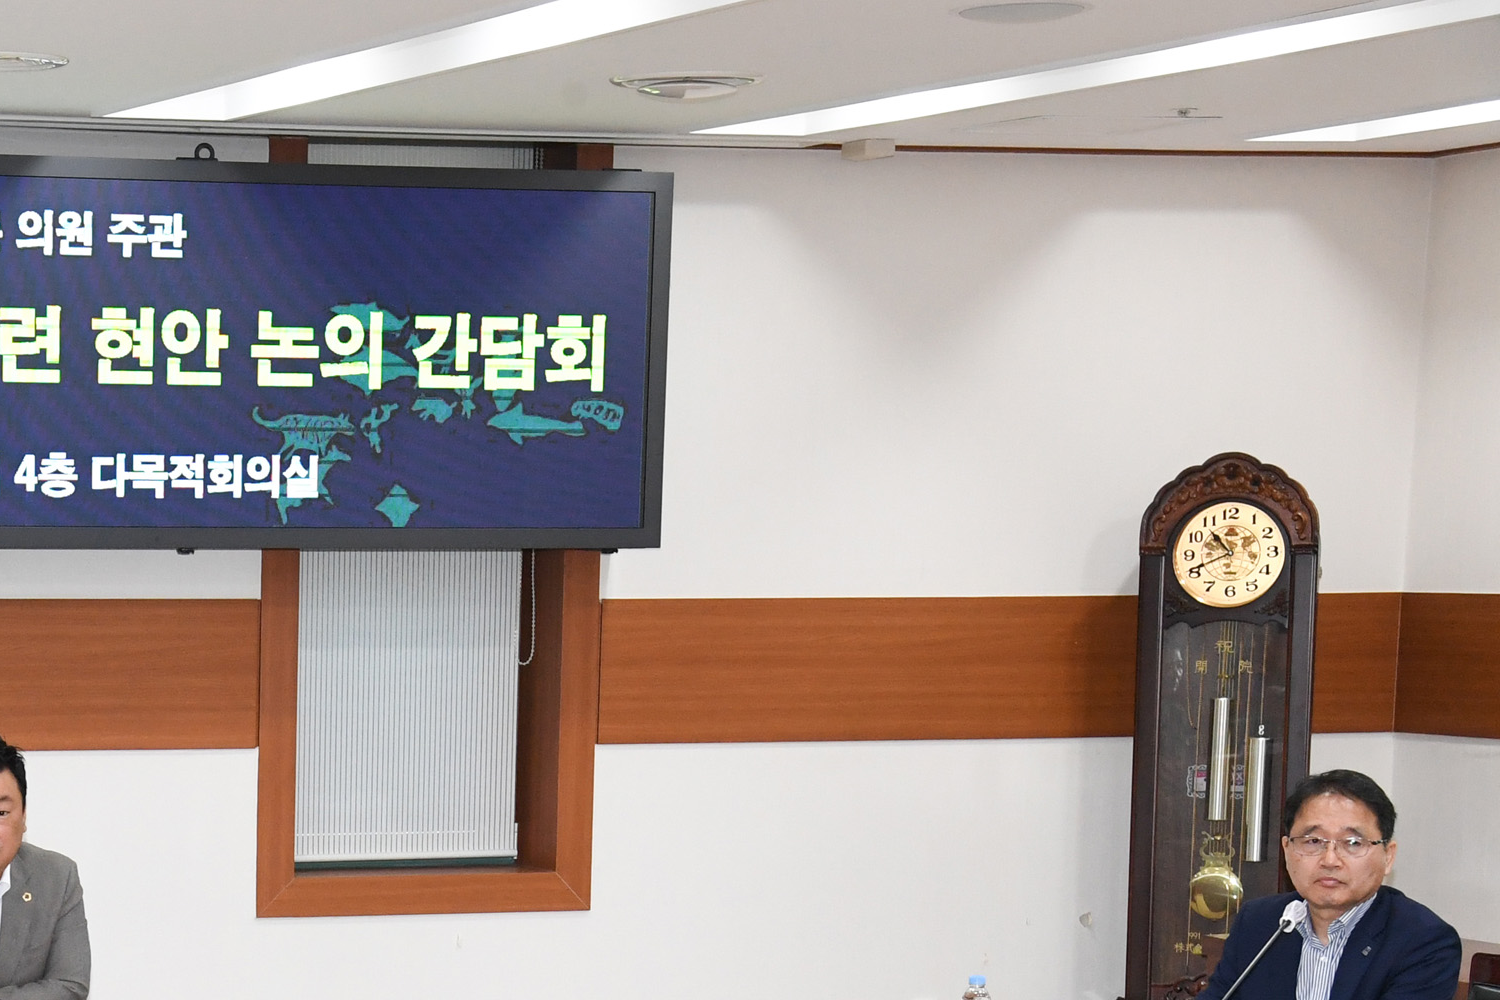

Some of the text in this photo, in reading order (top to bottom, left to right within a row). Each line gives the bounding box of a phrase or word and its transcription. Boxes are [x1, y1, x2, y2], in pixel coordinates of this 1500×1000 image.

[16, 210, 93, 256] 의원
[108, 214, 188, 258] 주관
[92, 308, 230, 387] 현안
[251, 311, 384, 390] 논의
[412, 313, 607, 392] 간담회
[14, 453, 79, 499] 4층
[92, 454, 320, 499] 다목적회의실
[1222, 507, 1239, 520] 12
[1252, 513, 1257, 525] 1
[1203, 515, 1216, 528] 11
[1189, 531, 1204, 543] 10
[1262, 527, 1274, 539] 2
[1184, 550, 1195, 561] 9
[1267, 546, 1279, 558] 3
[1188, 567, 1201, 579] 8
[1258, 564, 1273, 576] 4
[1203, 581, 1215, 593] 7
[1224, 585, 1236, 597] 6
[1246, 579, 1258, 592] 5
